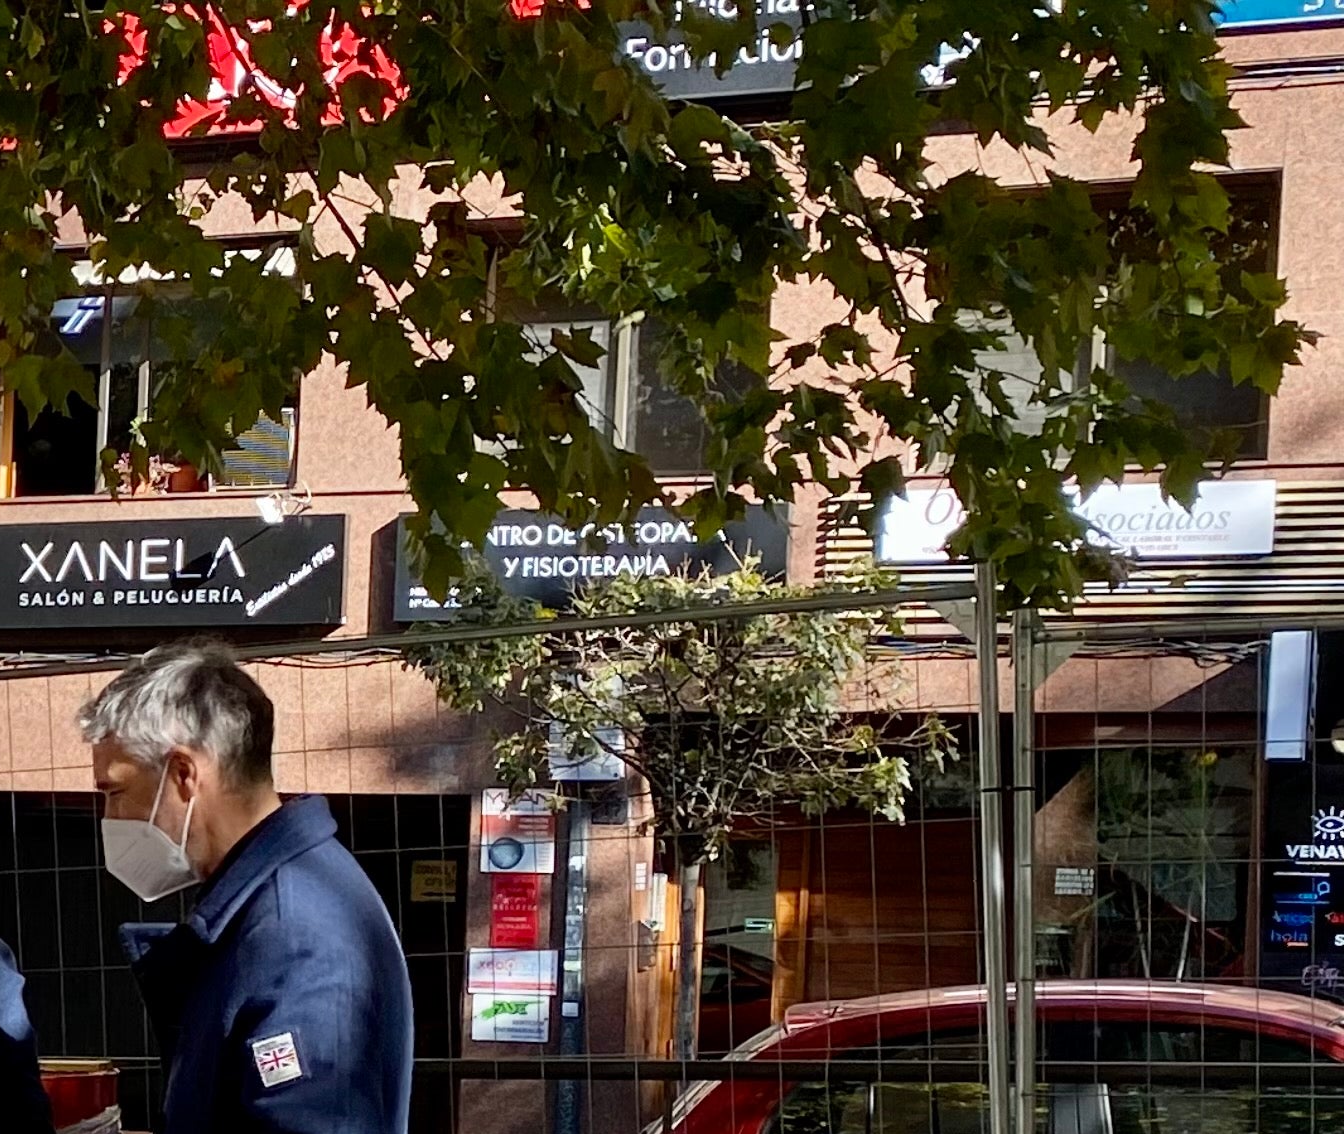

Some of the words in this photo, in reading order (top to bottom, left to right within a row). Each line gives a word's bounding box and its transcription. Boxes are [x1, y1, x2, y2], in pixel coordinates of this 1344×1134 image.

[547, 523, 577, 546] DE
[19, 536, 246, 583] XANELA
[503, 557, 520, 578] Y
[522, 554, 671, 577] FISIOTERAPIA
[19, 585, 84, 607] SALÓN
[93, 591, 105, 605] &
[113, 585, 244, 606] PELUQUERÍA
